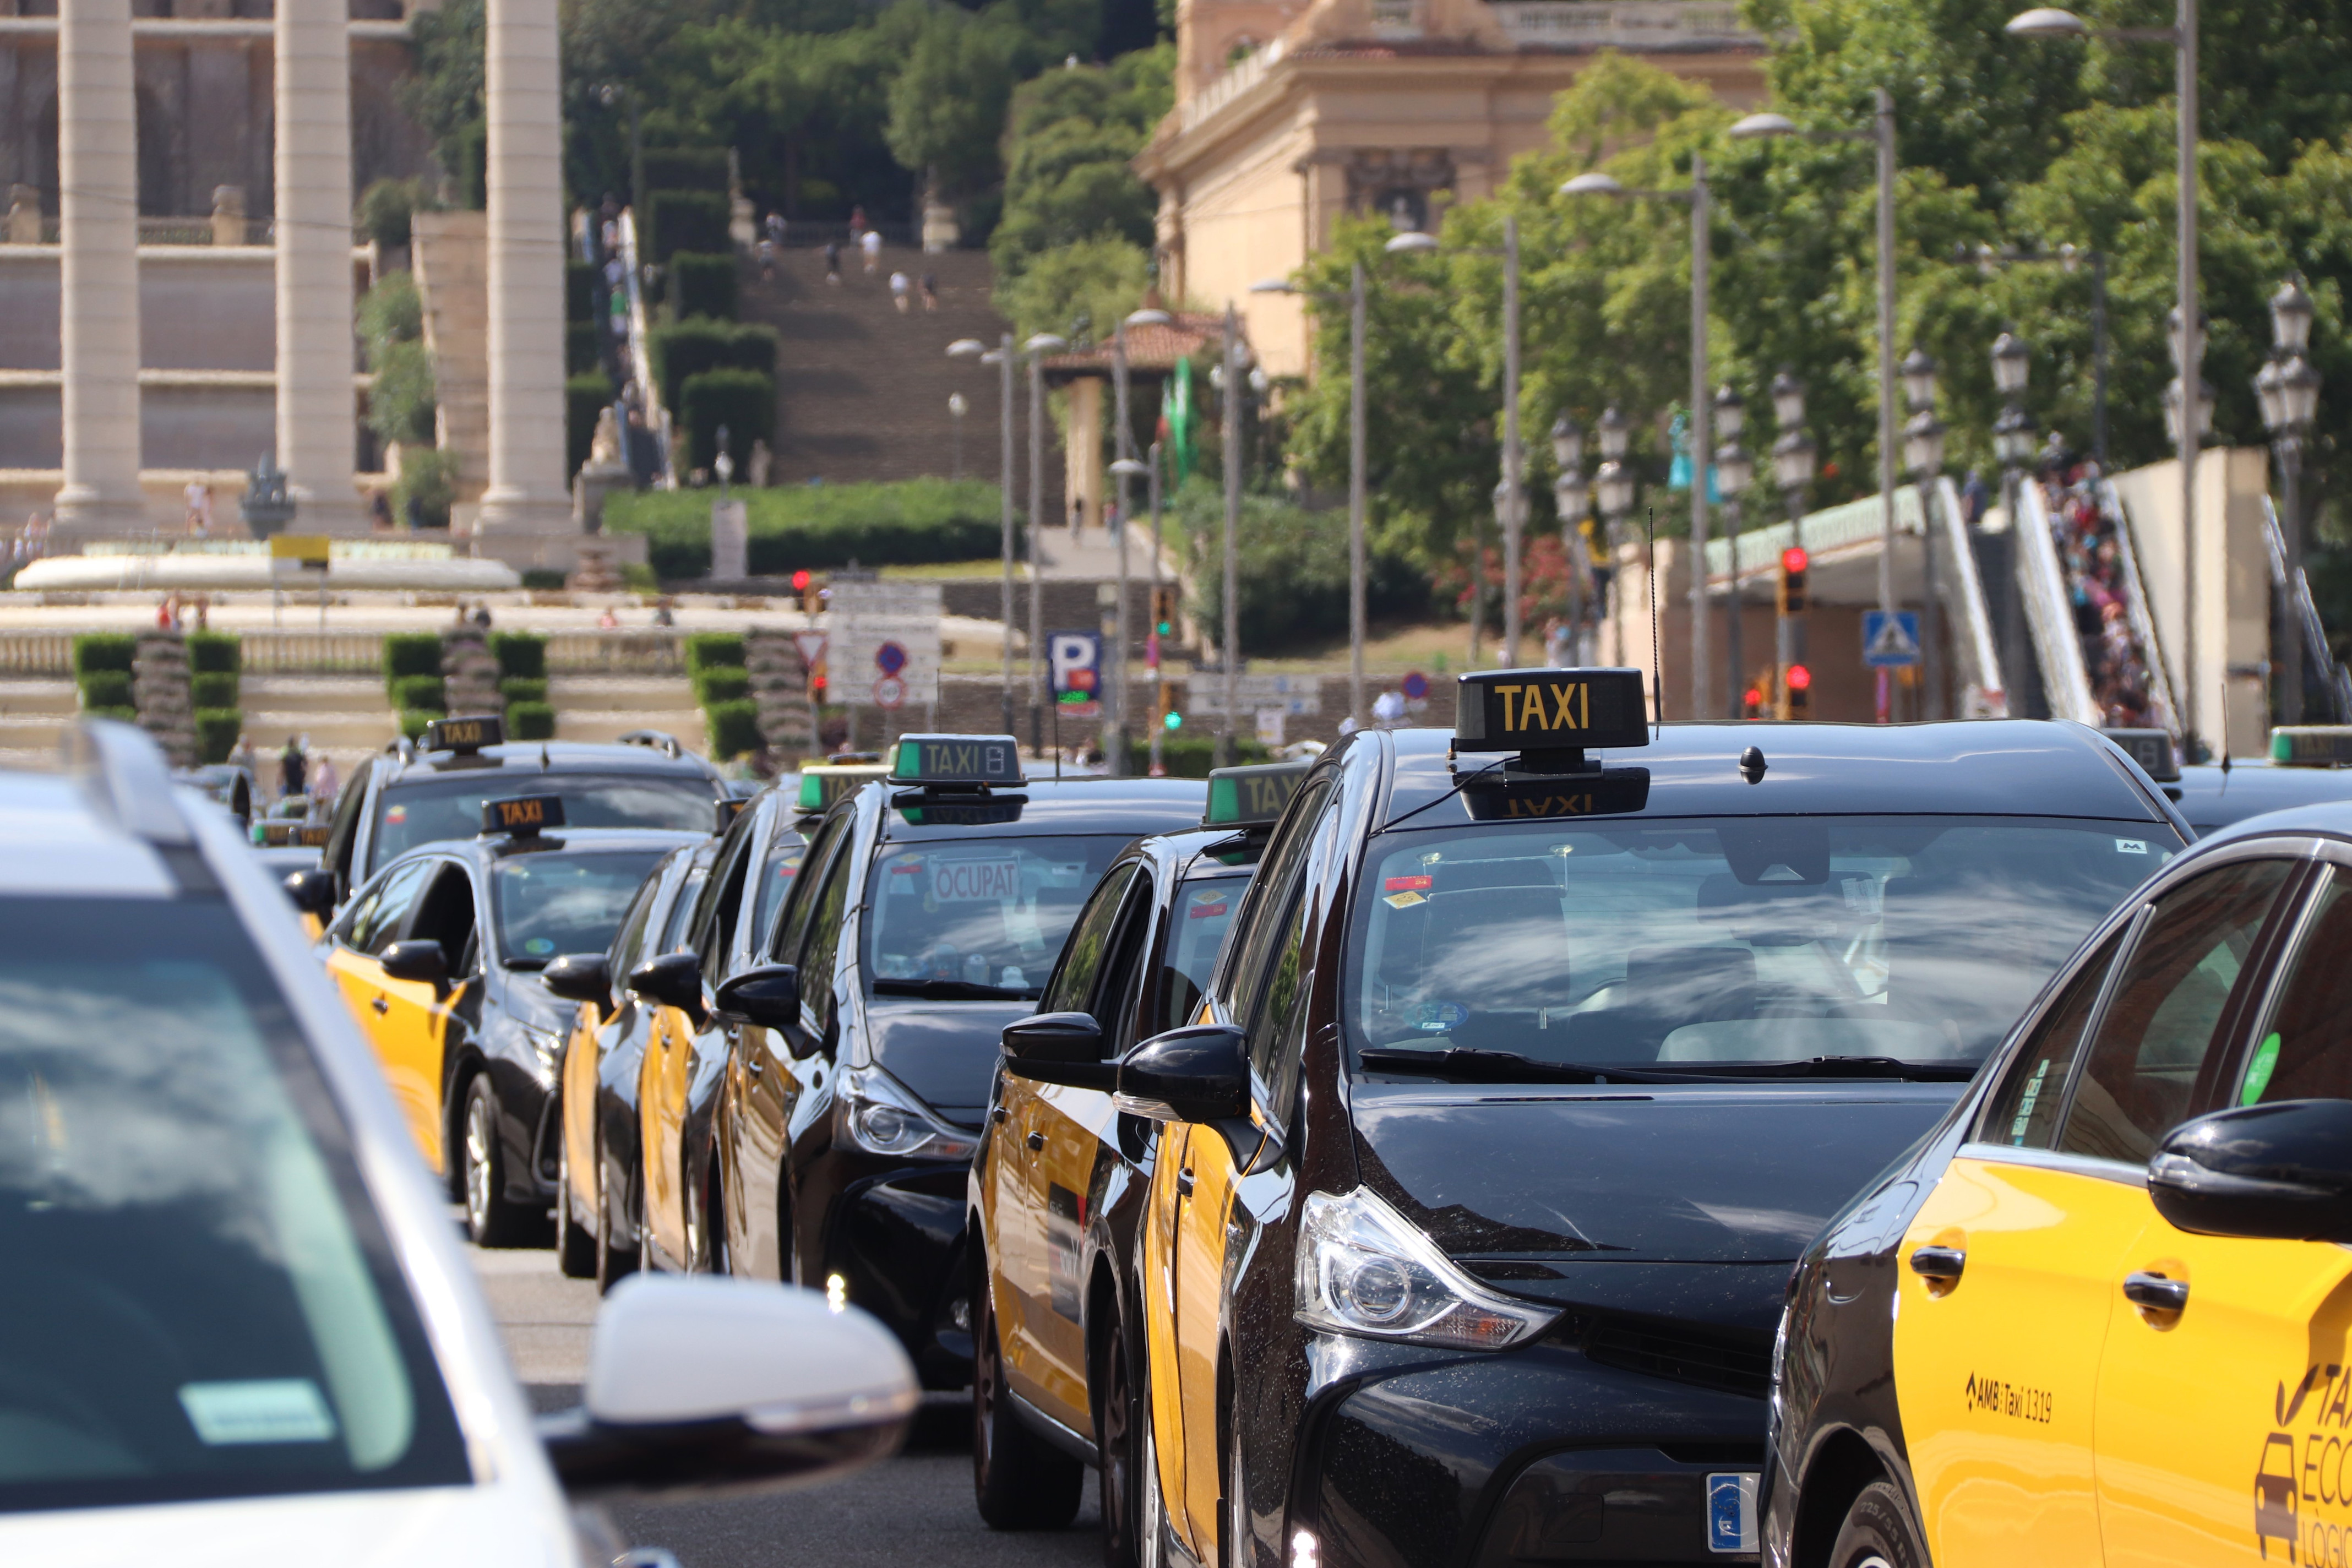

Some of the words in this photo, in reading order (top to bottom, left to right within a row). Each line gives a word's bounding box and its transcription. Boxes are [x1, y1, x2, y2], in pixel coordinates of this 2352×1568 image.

[1053, 635, 1096, 689] P
[1494, 683, 1589, 732] TAXI
[442, 720, 482, 743] TAXI
[926, 744, 979, 774] TAXI
[498, 799, 543, 825] TAXI
[937, 863, 1015, 899] OCUPAT
[1977, 1377, 2000, 1412] AMB
[2004, 1383, 2024, 1419] Taxi
[2026, 1387, 2052, 1424] 1319
[2317, 1362, 2352, 1430] TA
